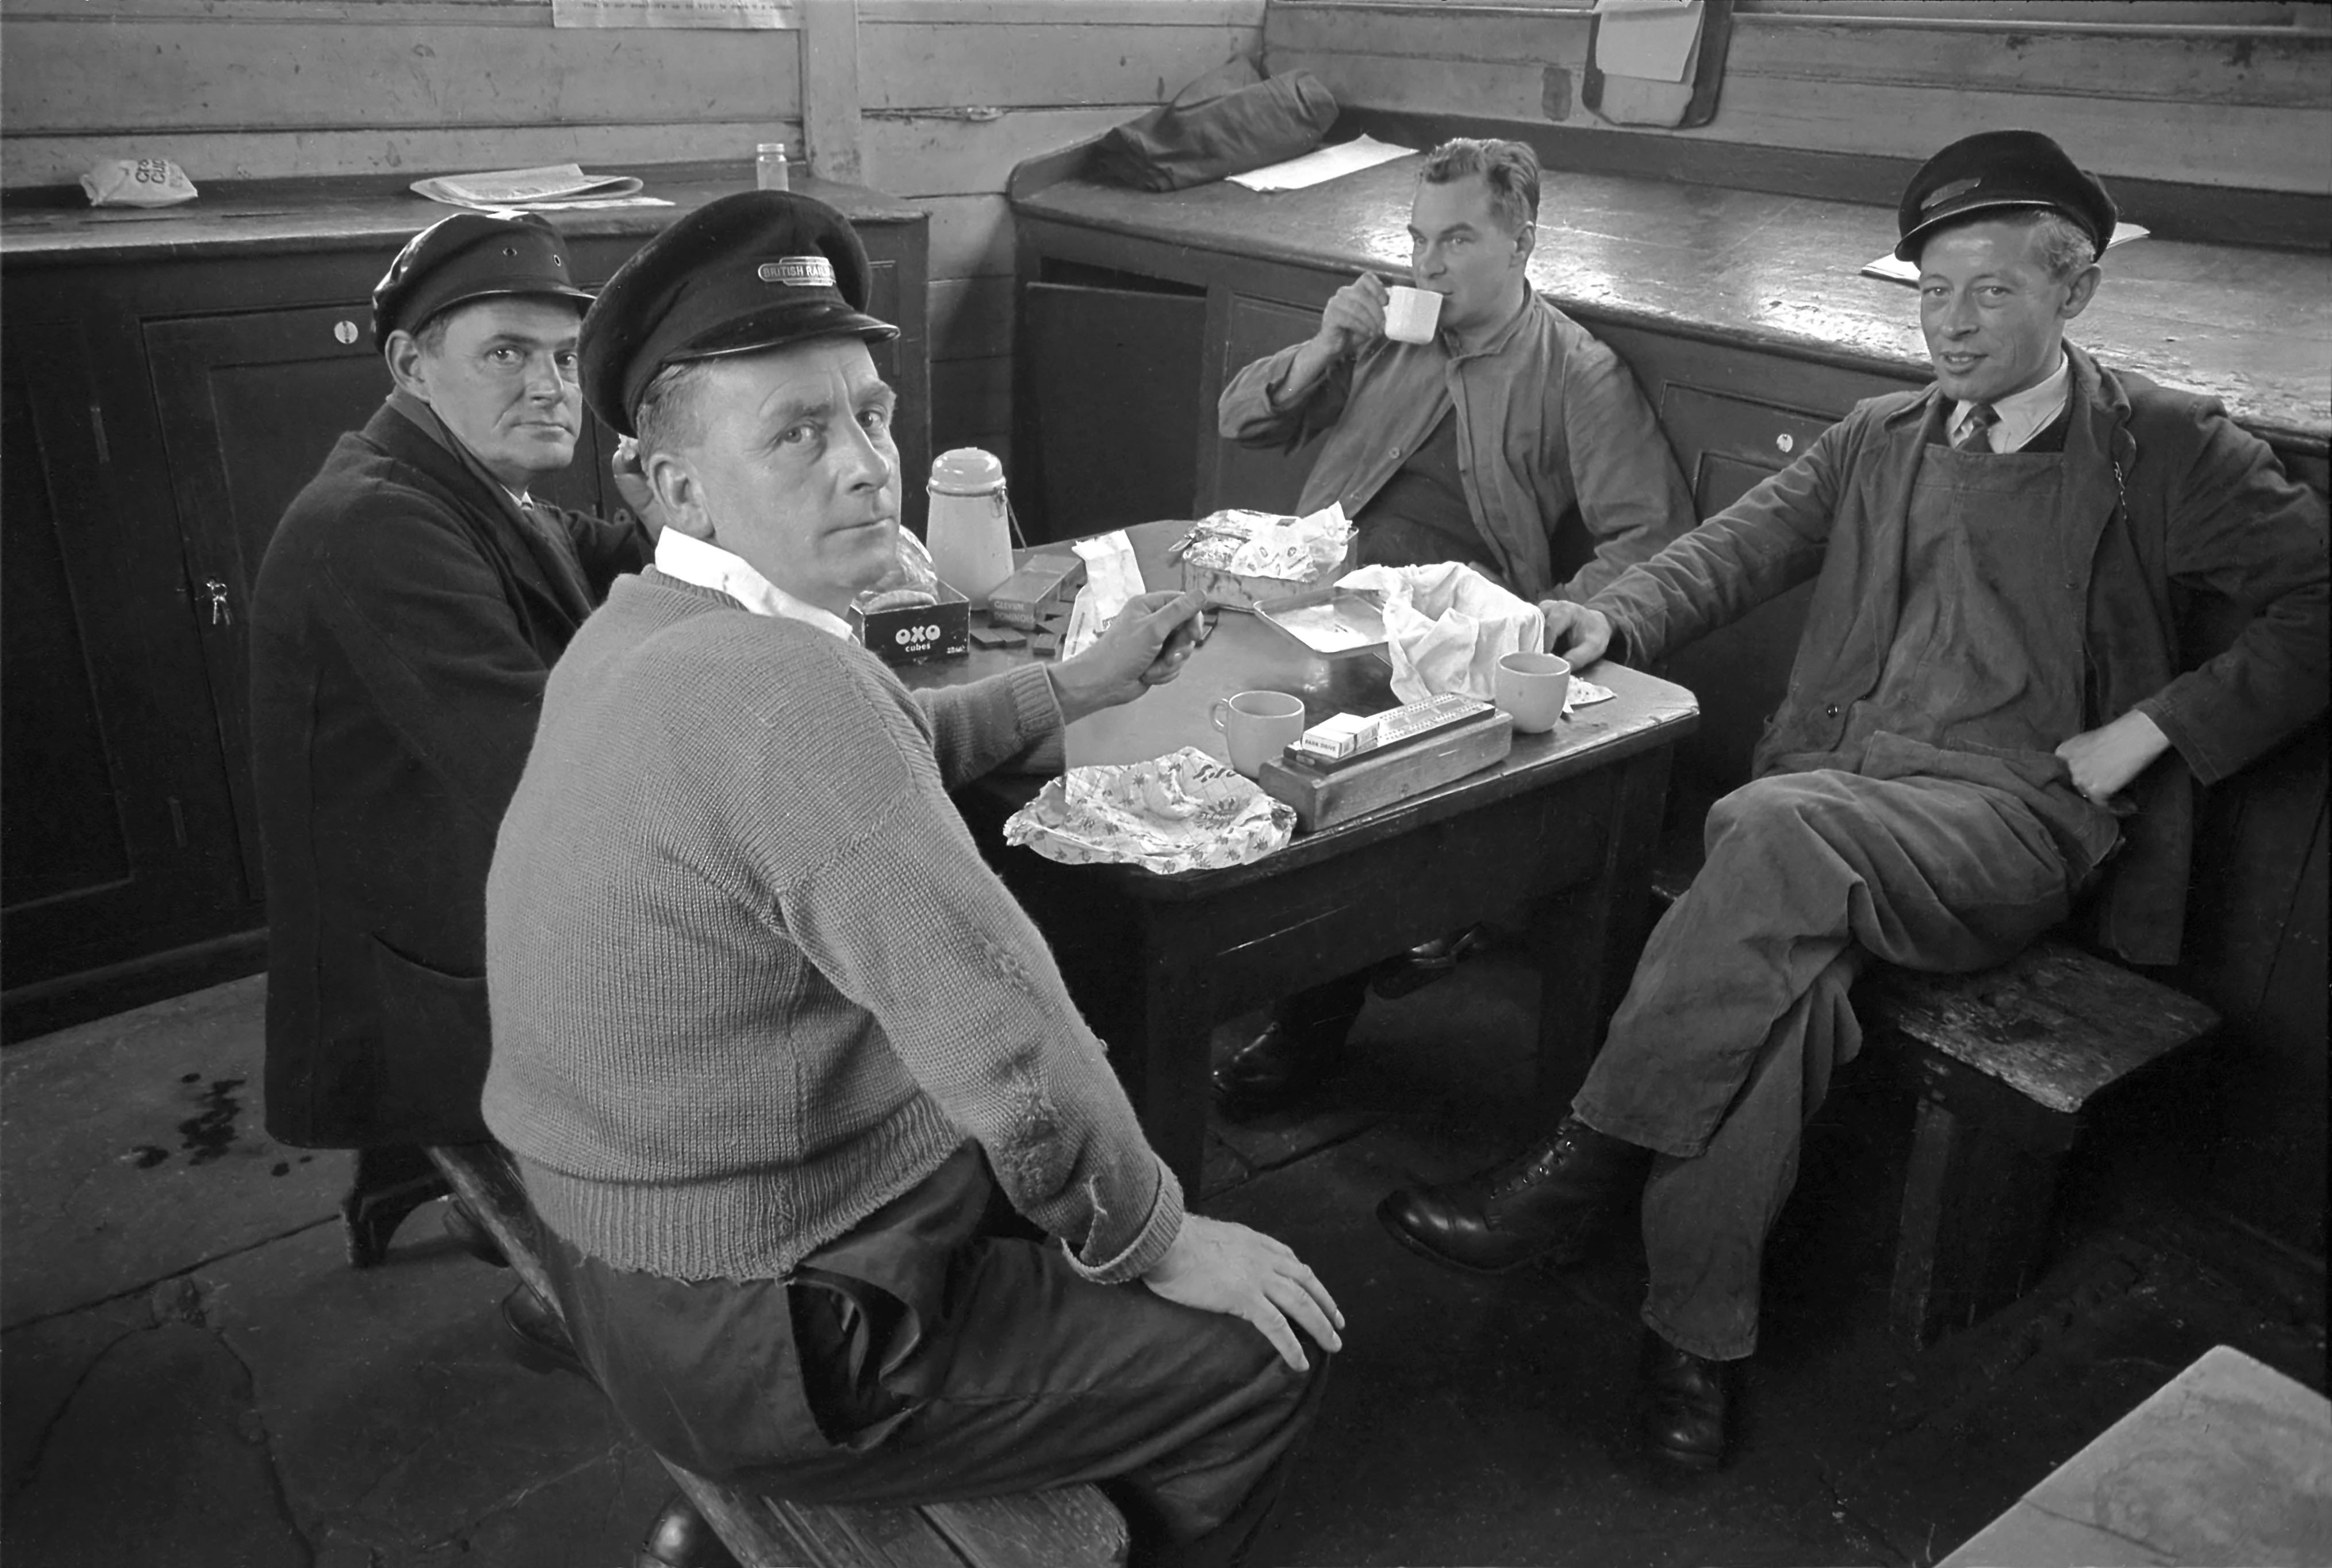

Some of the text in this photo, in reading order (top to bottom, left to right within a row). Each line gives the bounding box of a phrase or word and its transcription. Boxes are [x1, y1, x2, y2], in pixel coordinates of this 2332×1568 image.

[763, 265, 804, 278] BRITISH
[994, 600, 1025, 610] GLEVUM
[994, 611, 1035, 624] DOMINOES
[895, 624, 941, 645] OXO
[905, 643, 931, 652] cubes
[1305, 739, 1336, 751] PARK DRIVE
